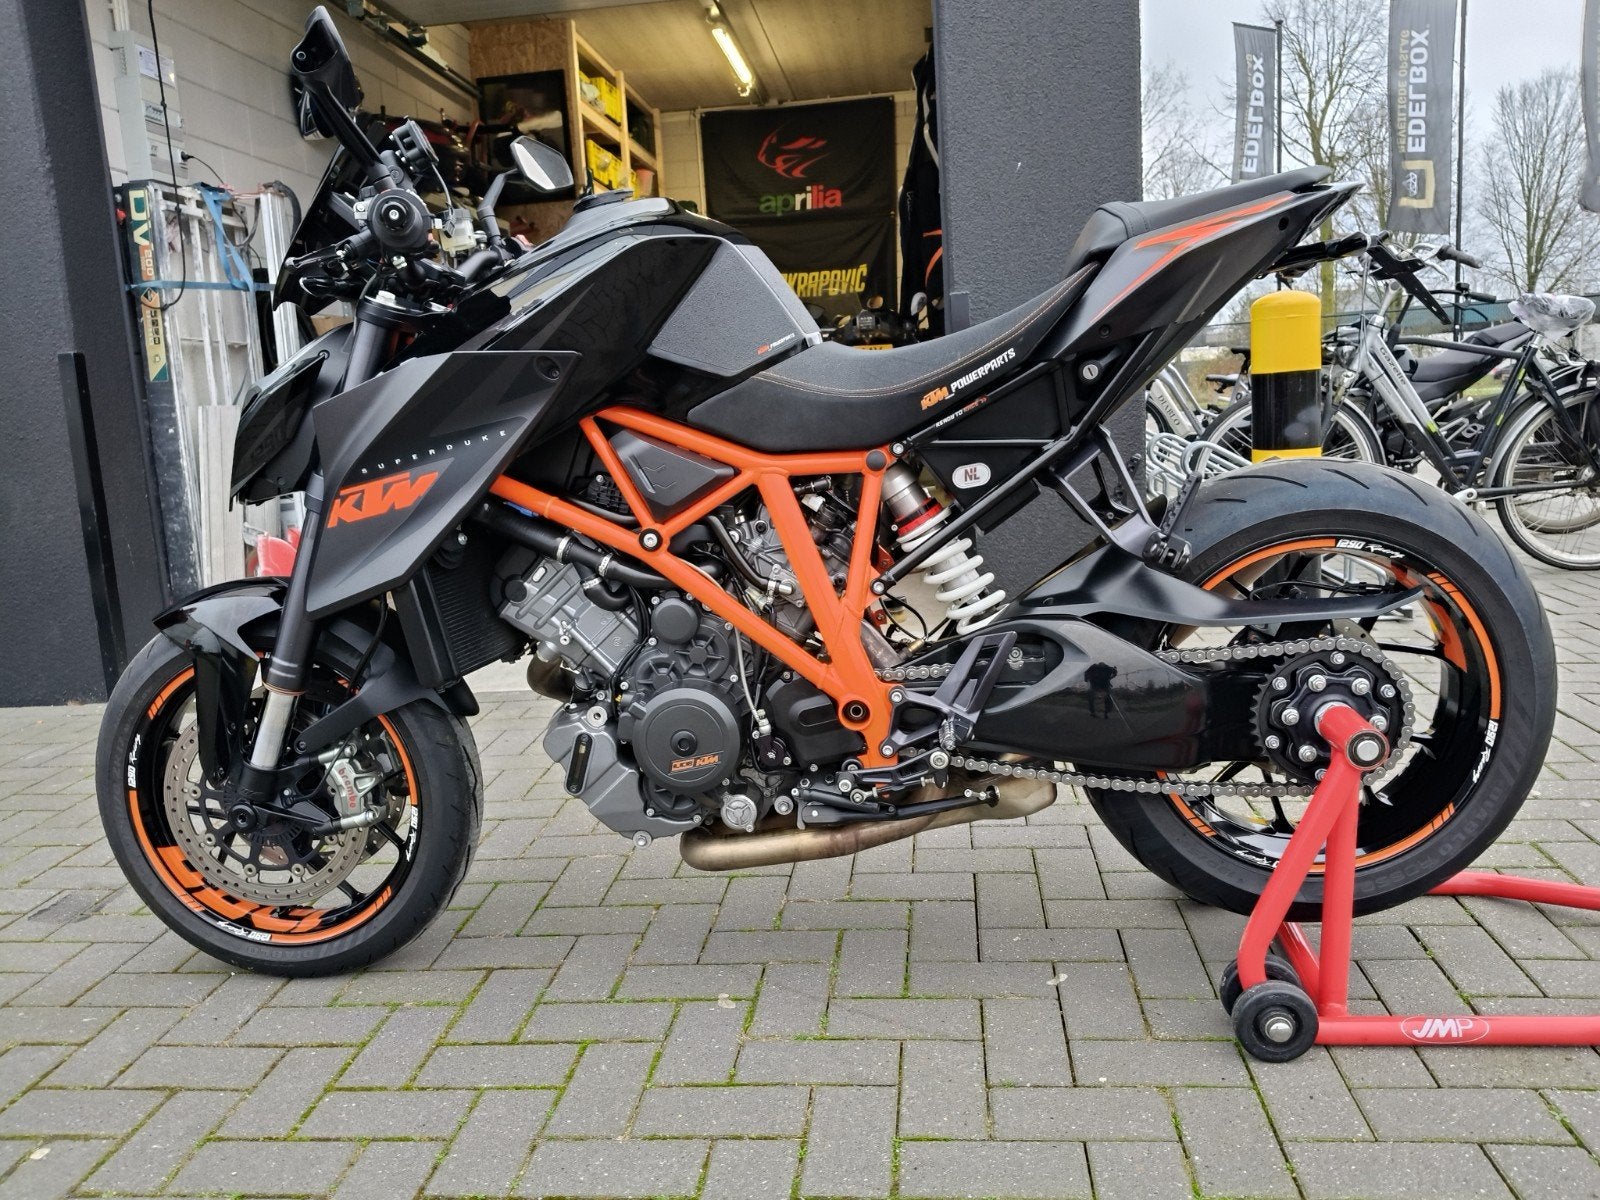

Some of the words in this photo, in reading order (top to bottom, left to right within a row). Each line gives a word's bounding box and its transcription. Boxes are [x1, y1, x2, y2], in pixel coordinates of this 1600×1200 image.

[759, 185, 842, 216] aprilia
[921, 386, 949, 411] KTM
[950, 347, 1016, 393] POWERPARTS
[964, 467, 980, 482] NL
[327, 471, 439, 529] KTM
[1336, 538, 1366, 550] 1290
[338, 767, 356, 808] brembo
[1412, 1018, 1474, 1038] JMP
